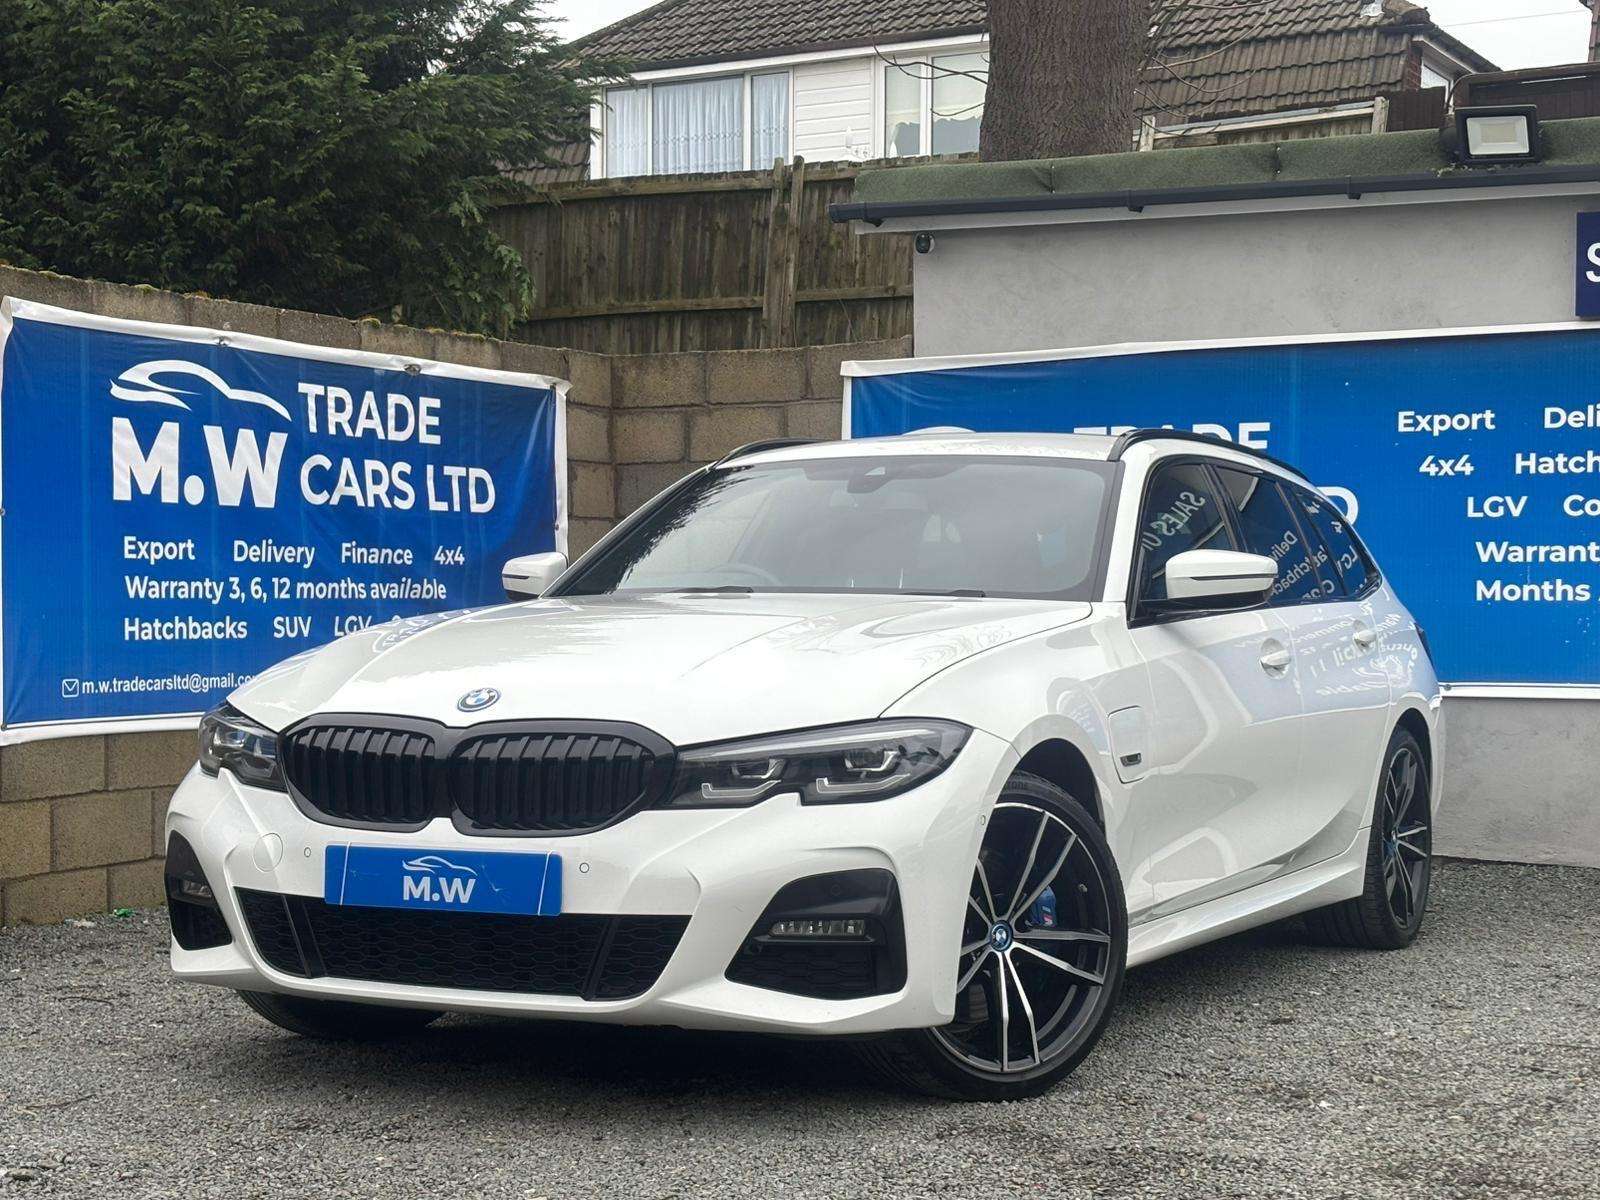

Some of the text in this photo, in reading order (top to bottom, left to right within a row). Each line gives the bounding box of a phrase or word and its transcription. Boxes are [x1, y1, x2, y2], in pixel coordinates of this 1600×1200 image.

[298, 382, 442, 444] TRADE
[1398, 410, 1496, 437] Export
[112, 416, 289, 508] M.W
[1419, 450, 1600, 476] 4x4 Hatch
[301, 454, 496, 513] CARS LTD
[1468, 495, 1528, 518] LGV
[123, 536, 465, 569] Export Delivery Finance 4x4
[1475, 541, 1600, 563] Warrant
[125, 575, 447, 604] Warranty 3, 6, 12 months available
[1476, 579, 1591, 602] Months
[124, 615, 248, 641] Hatchbacks
[273, 617, 312, 639] SUV
[334, 615, 372, 638] LGV
[82, 673, 257, 693] m.w.tradecarsltd@gmail.co
[403, 875, 477, 904] M.W
